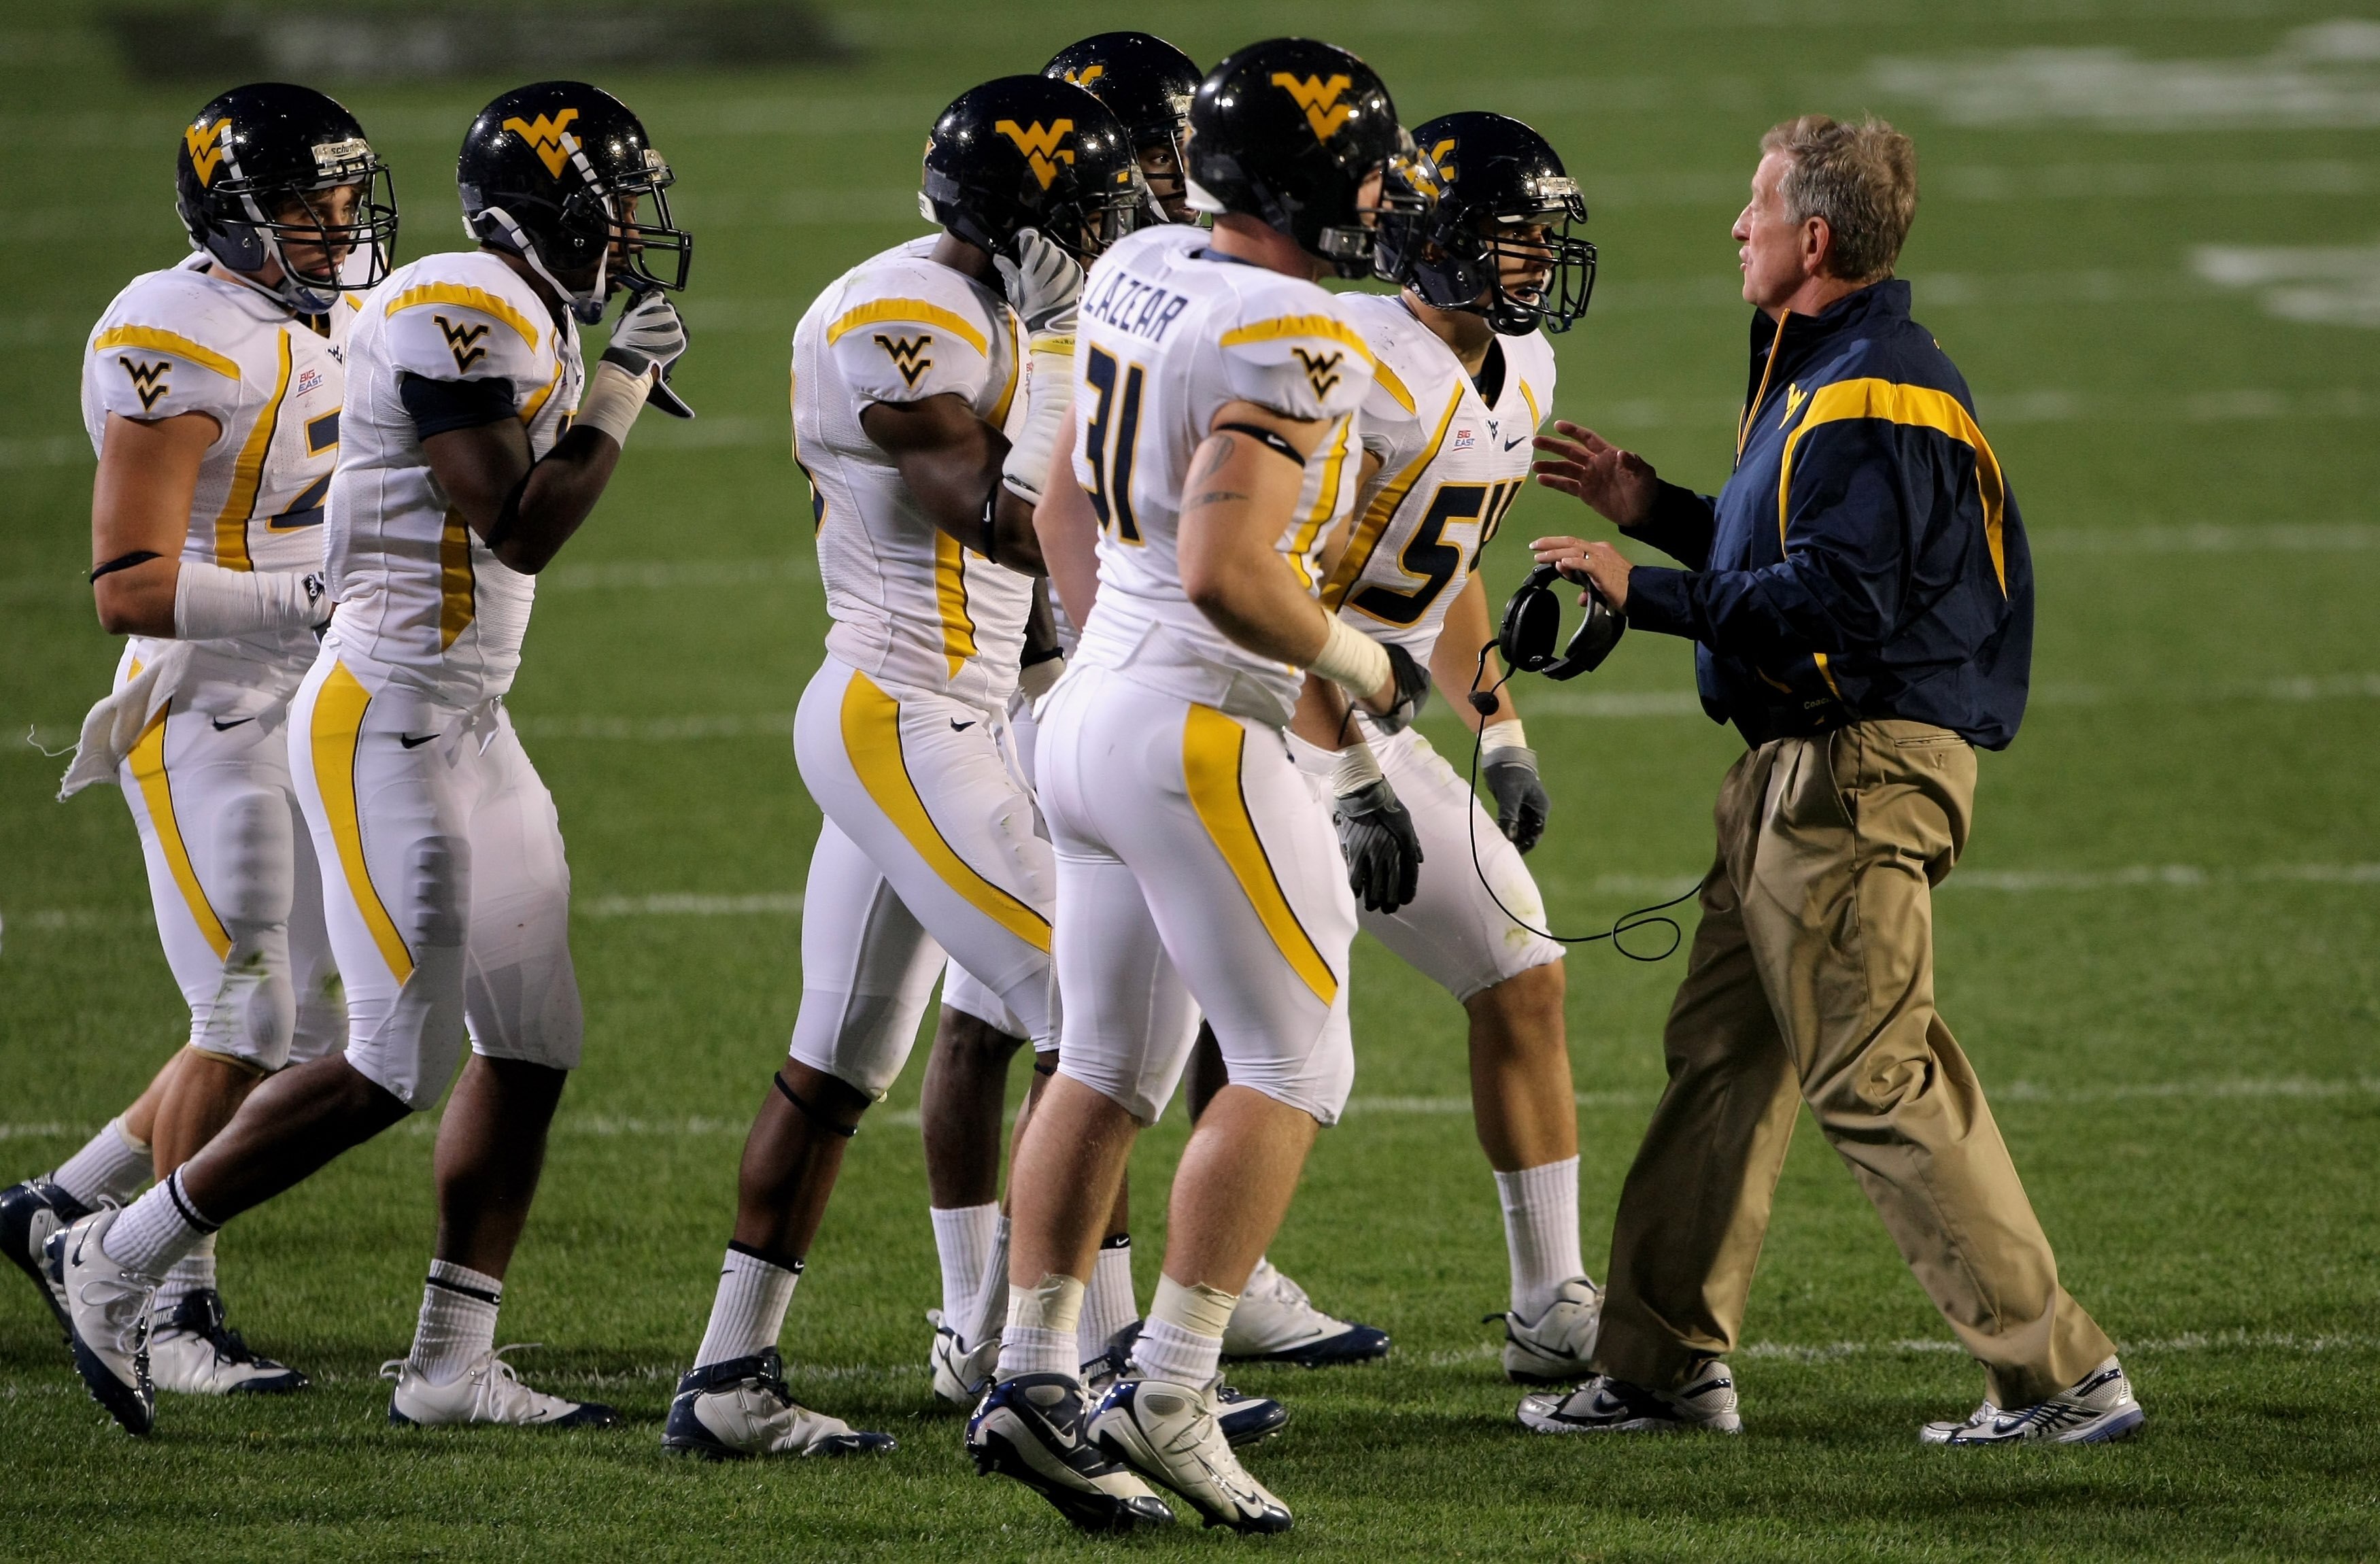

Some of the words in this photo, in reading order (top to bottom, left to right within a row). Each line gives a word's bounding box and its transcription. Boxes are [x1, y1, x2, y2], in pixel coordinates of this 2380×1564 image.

[1084, 267, 1188, 342] LAZEAR
[298, 375, 322, 392] EAST
[299, 369, 315, 383] BIG
[1455, 439, 1475, 447] EAST
[1457, 430, 1472, 439] BIG
[1084, 340, 1147, 547] 31
[1344, 475, 1527, 629] 54
